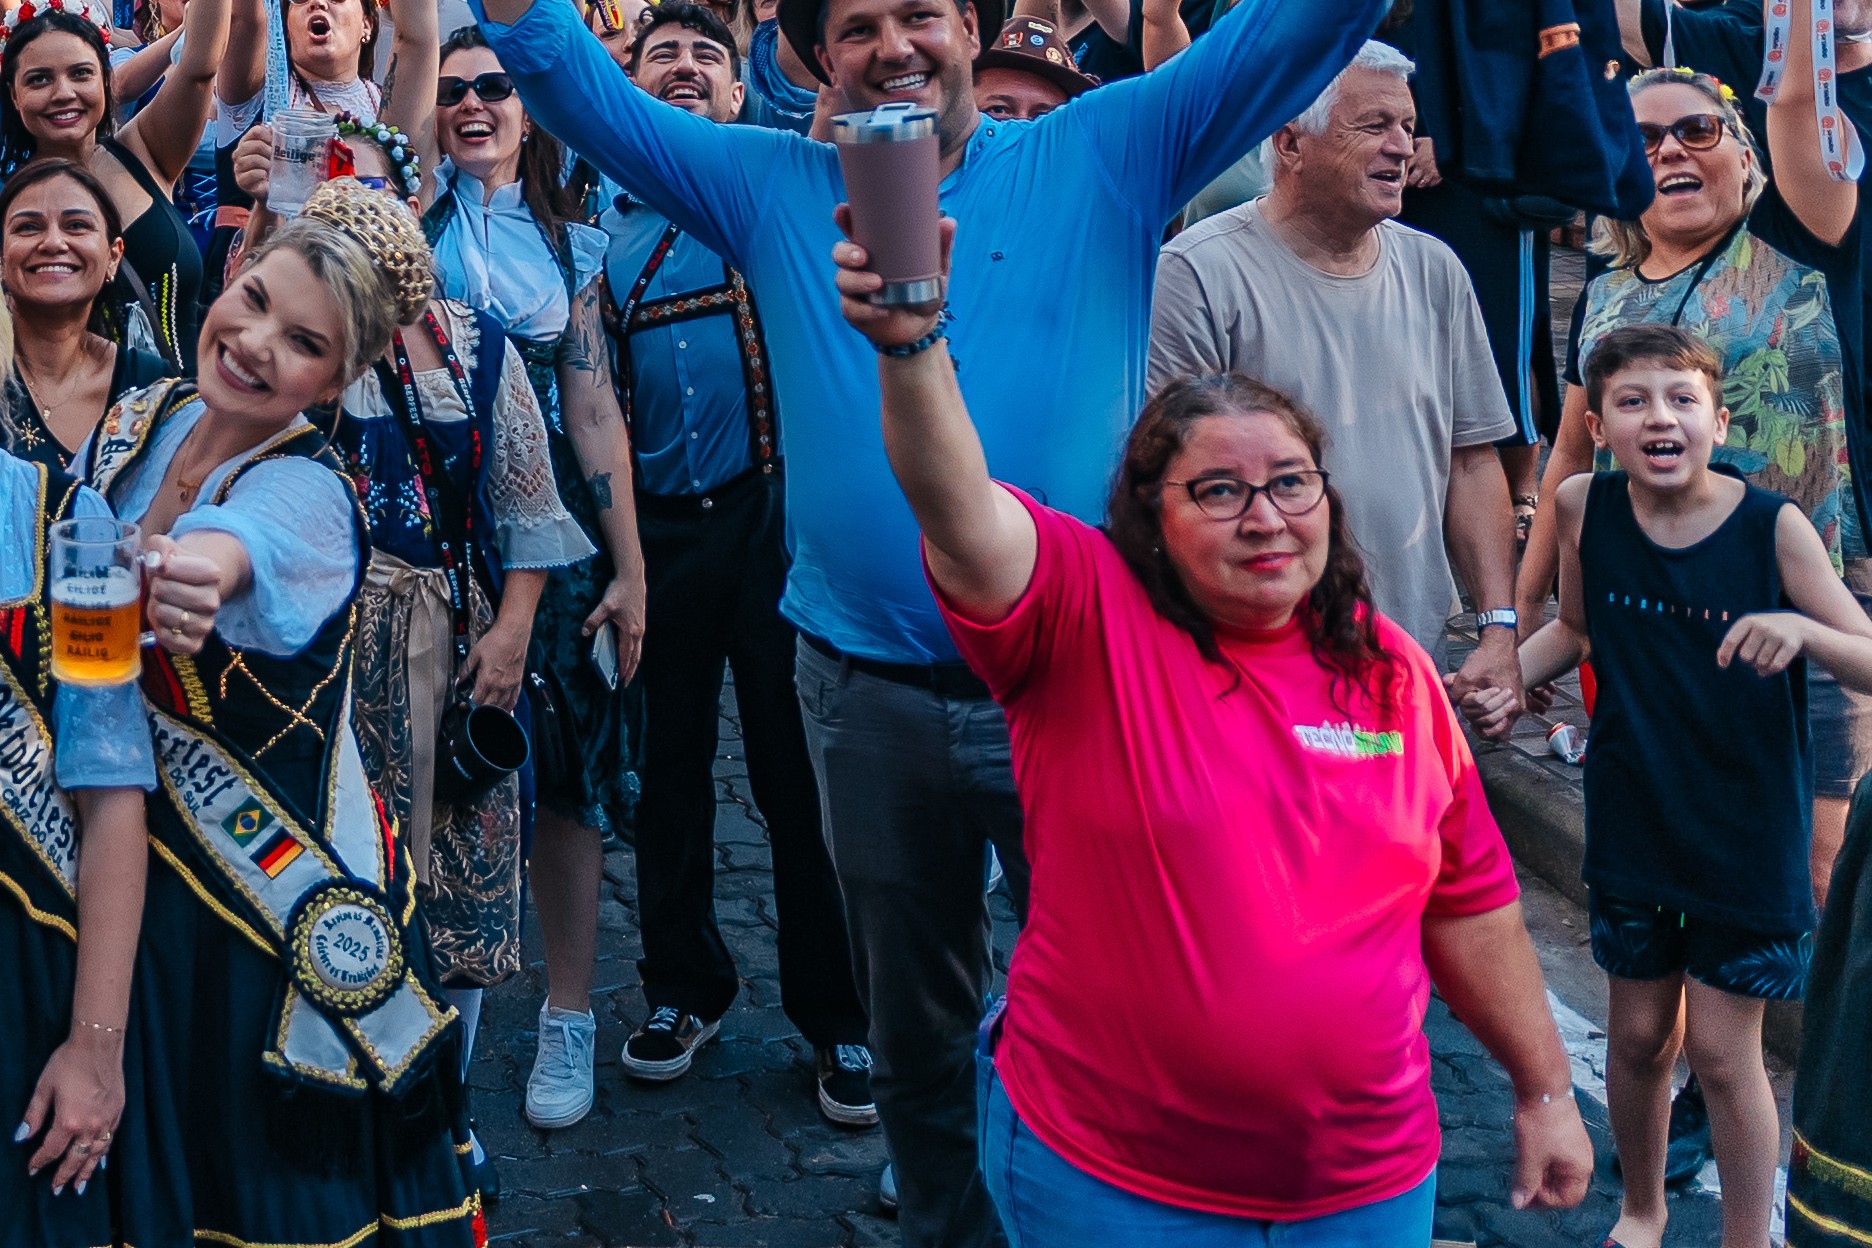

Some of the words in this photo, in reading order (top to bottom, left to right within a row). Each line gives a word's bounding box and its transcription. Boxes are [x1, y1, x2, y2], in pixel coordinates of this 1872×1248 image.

[426, 312, 447, 346] KTO
[415, 437, 432, 475] KTO
[169, 767, 186, 788] DO
[184, 790, 200, 819] SUL
[1, 786, 32, 820] CRUZ
[30, 819, 49, 845] DO
[47, 844, 65, 872] SUL
[333, 932, 370, 963] 2025
